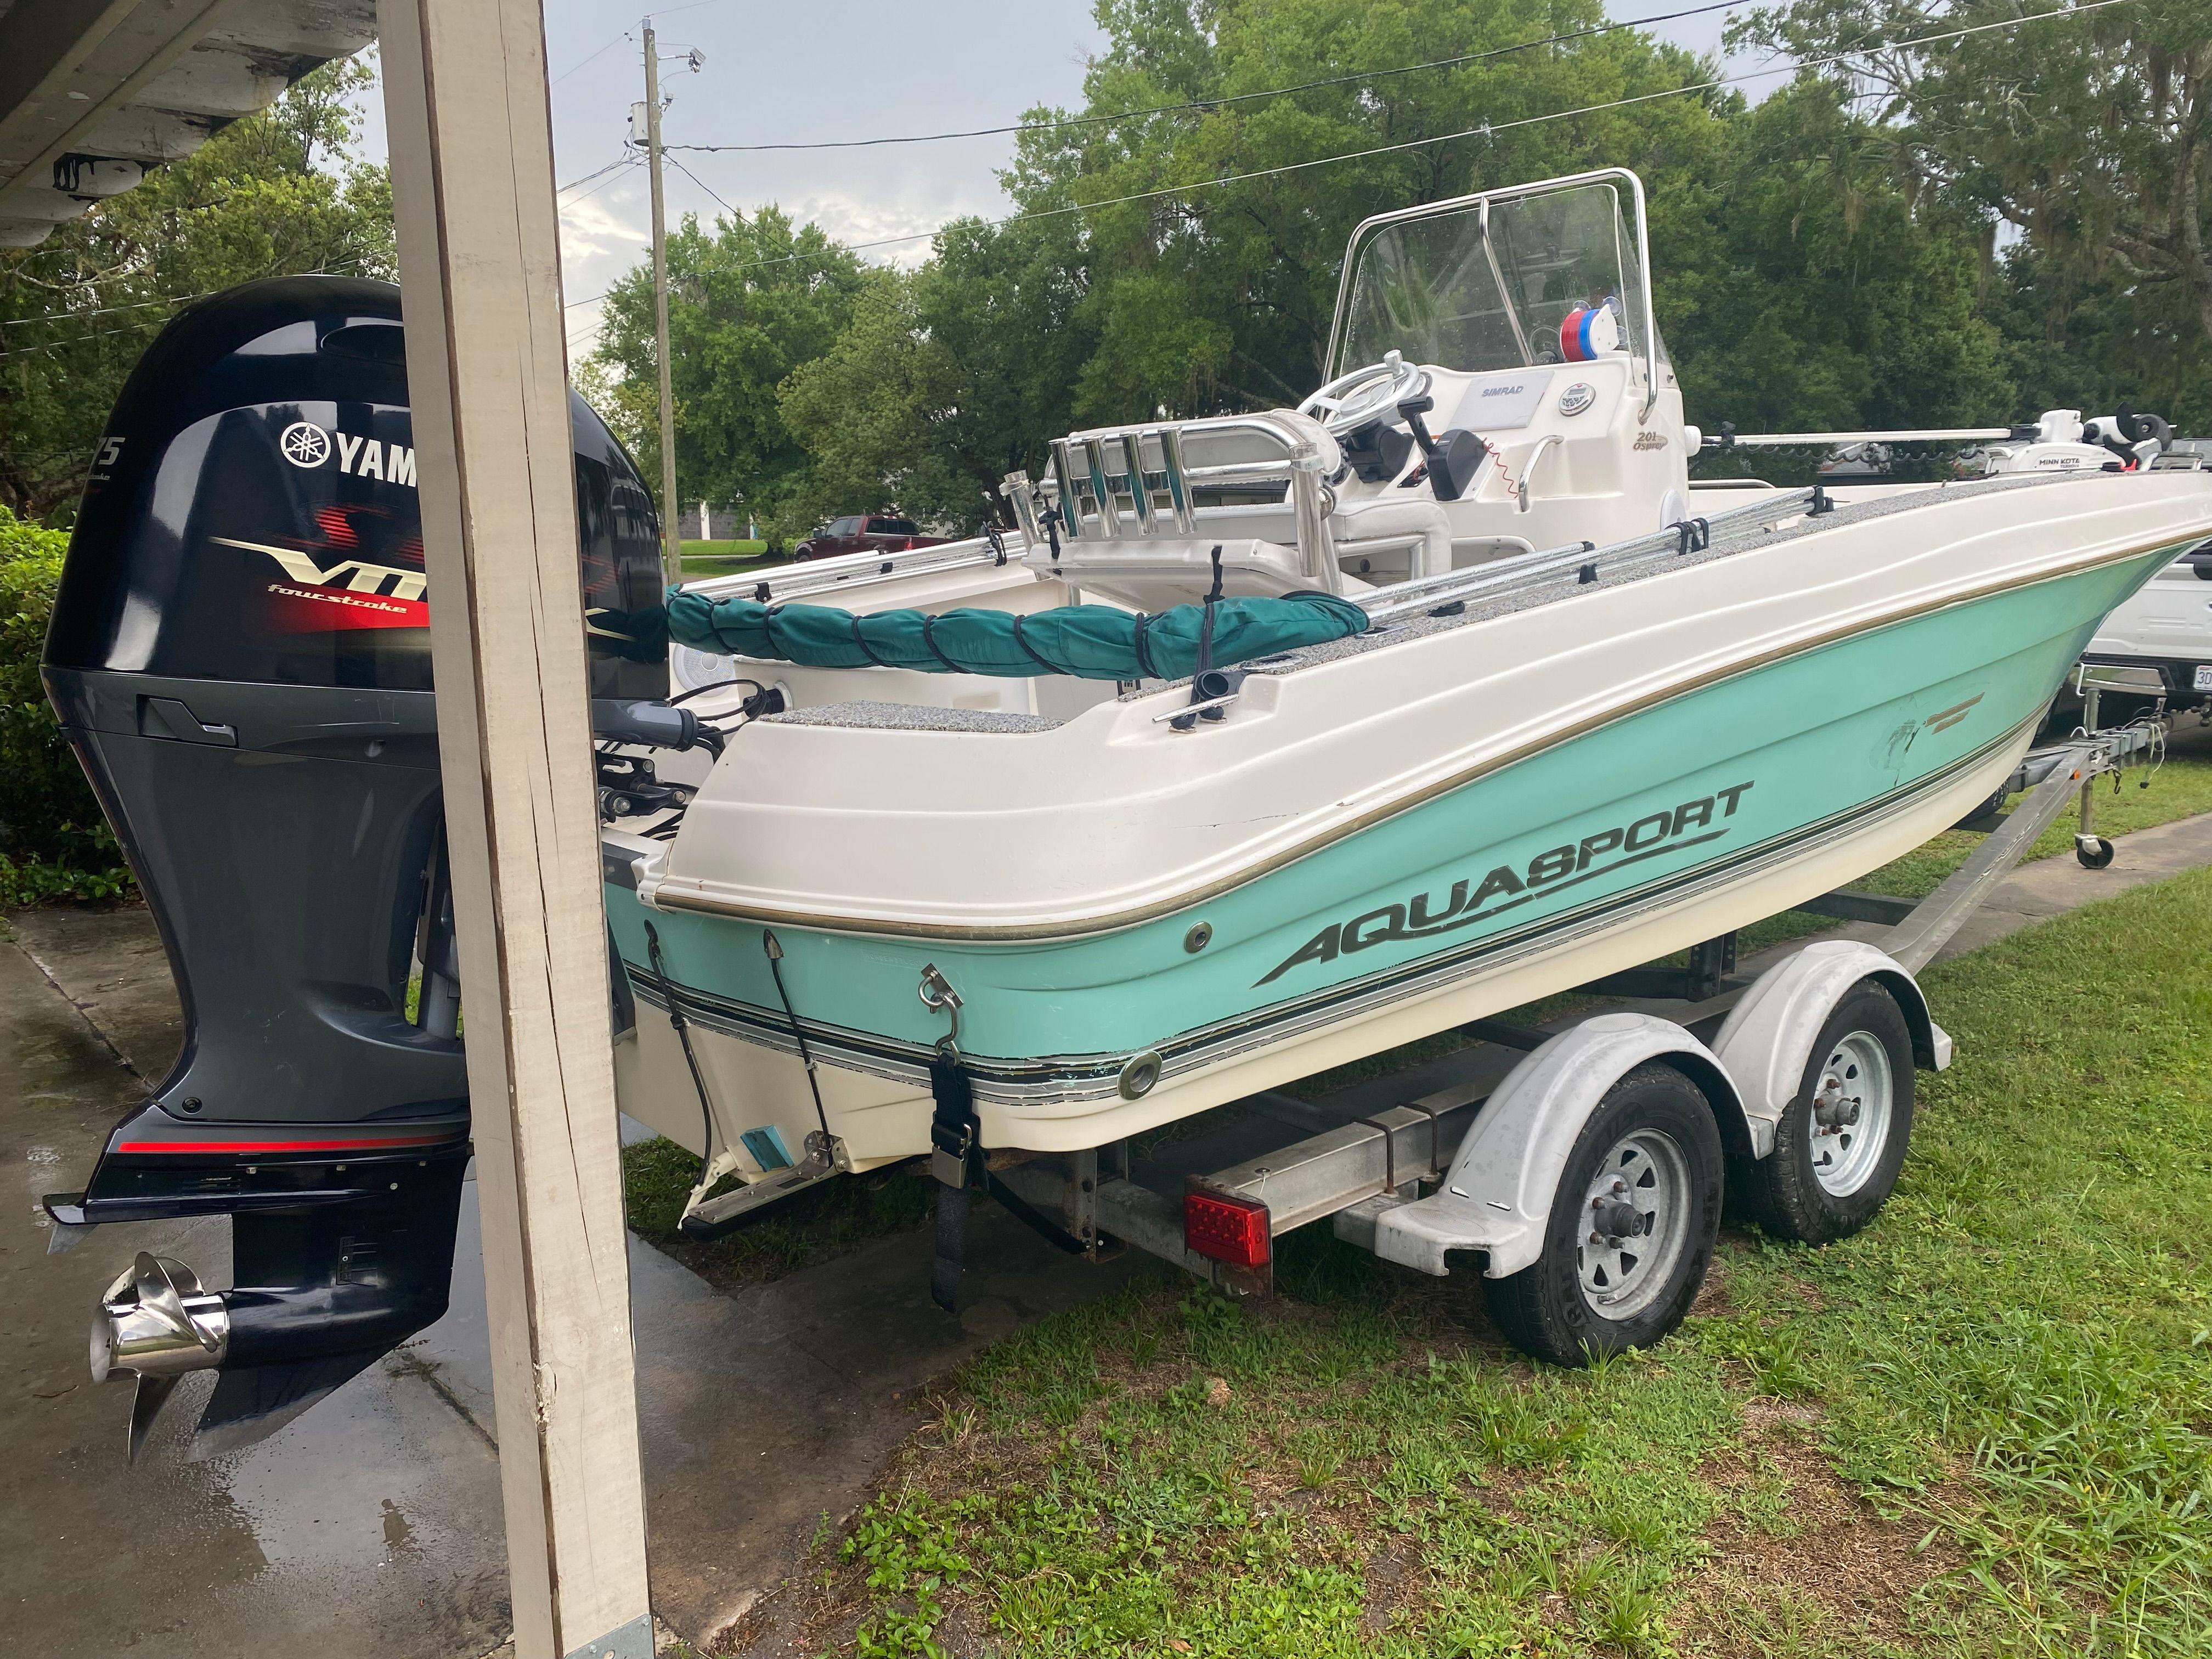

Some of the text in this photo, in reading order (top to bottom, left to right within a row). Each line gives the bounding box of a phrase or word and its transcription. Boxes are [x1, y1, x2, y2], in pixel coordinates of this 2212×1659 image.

[1482, 386, 1524, 397] SIMRAD
[1637, 432, 1657, 442] 201
[1633, 442, 1664, 451] Osprey
[1250, 780, 1756, 989] AQUASPORT
